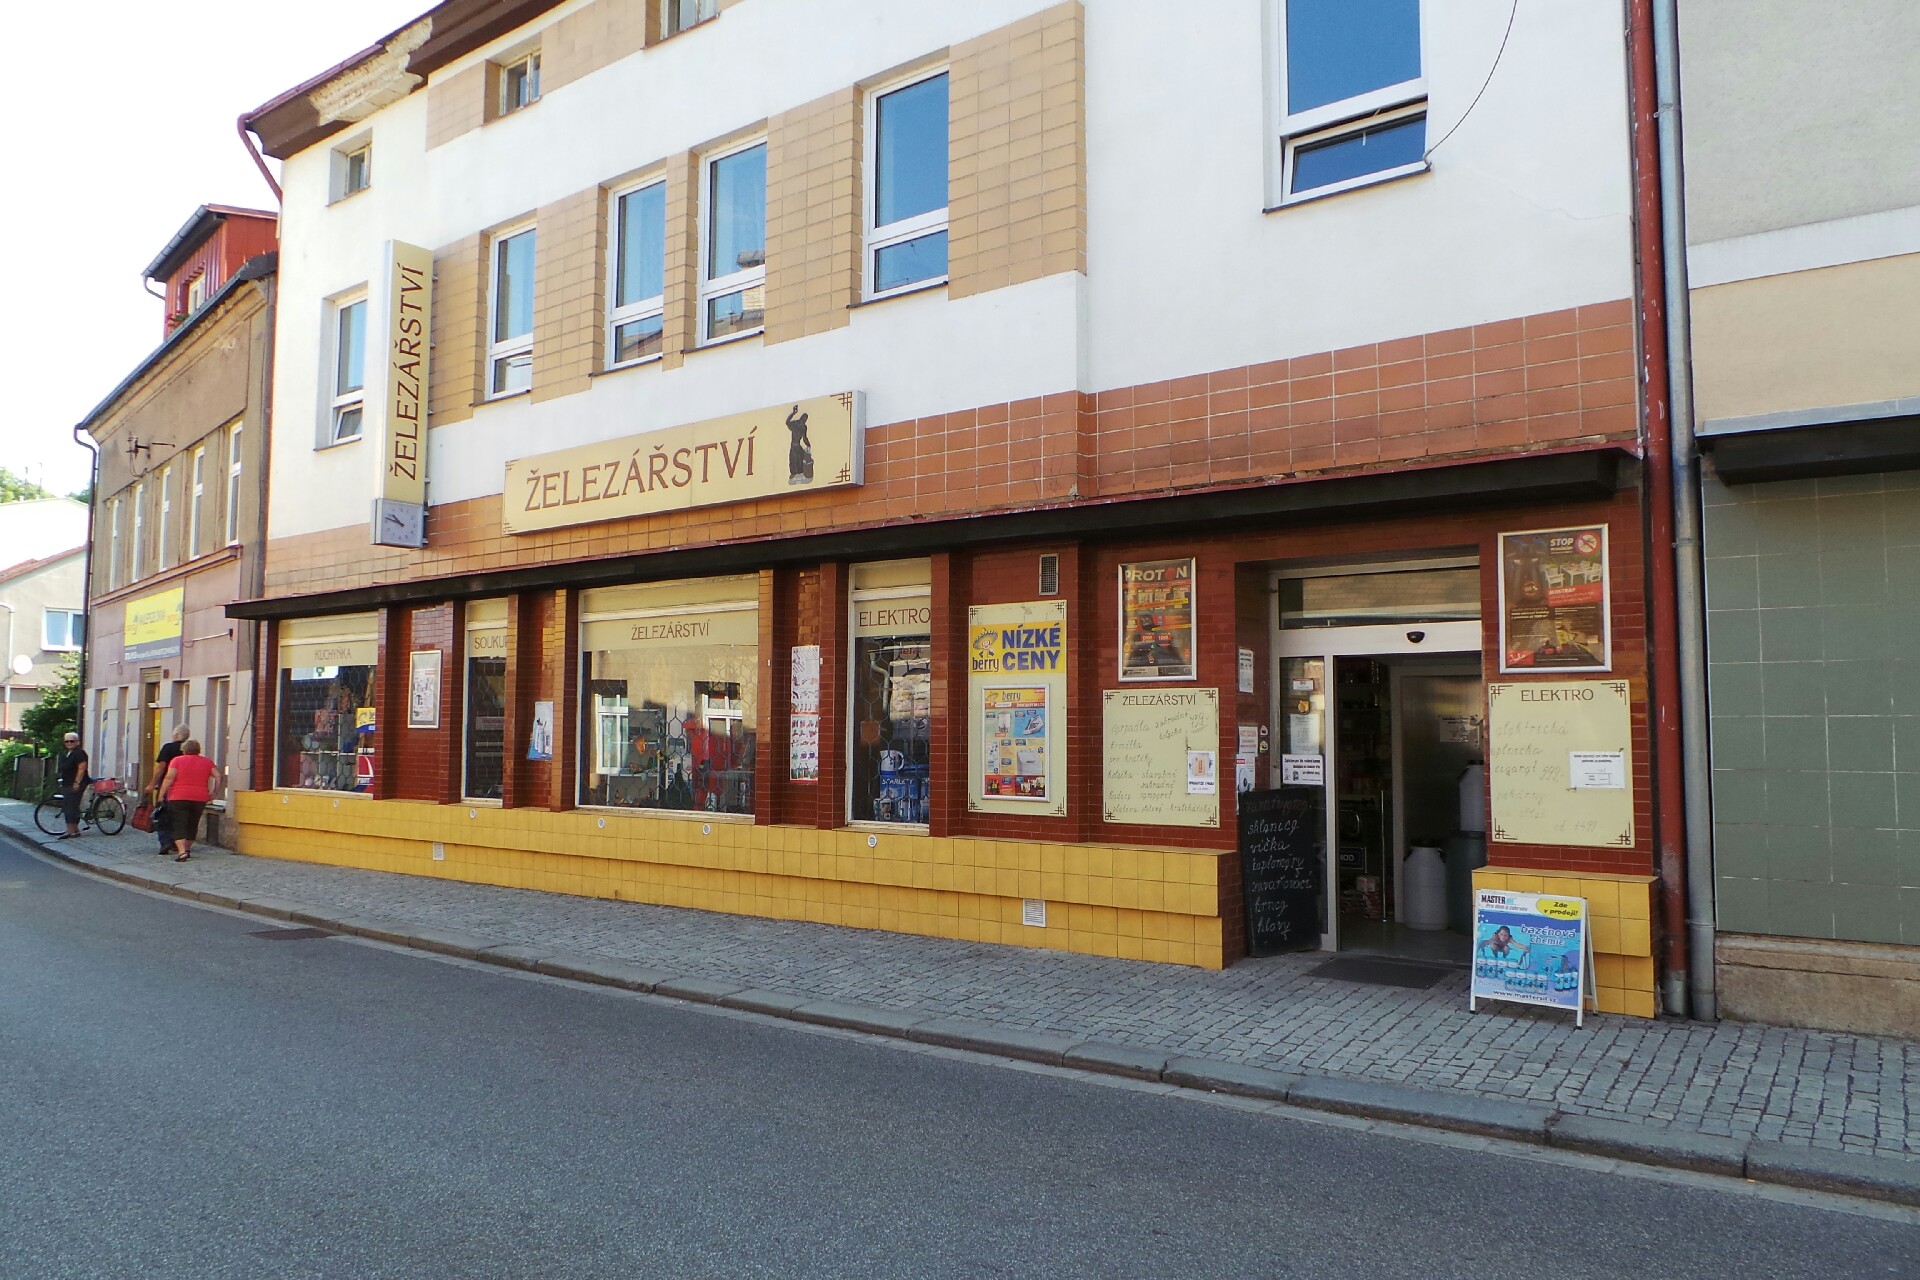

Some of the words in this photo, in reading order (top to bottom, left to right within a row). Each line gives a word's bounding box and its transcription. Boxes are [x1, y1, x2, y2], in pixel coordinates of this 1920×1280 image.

[389, 262, 424, 480] ŽELEZÁŘSTVÍ
[524, 425, 758, 512] ŽELEZÁŘSTVÍ
[1550, 537, 1574, 547] STOP
[859, 607, 931, 627] ELEKTRO
[631, 618, 711, 641] ŽELEZÁŘSTVÍ
[1001, 622, 1061, 649] NÍZKÉ
[314, 647, 352, 661] KUCHYŇKA
[1002, 649, 1061, 671] CENY
[972, 656, 999, 673] berry
[1001, 691, 1021, 701] berry
[1122, 692, 1197, 706] ŽELEZÁŘSTVÍ
[1520, 688, 1595, 702] ELEKTRO
[1521, 924, 1576, 938] bazénová
